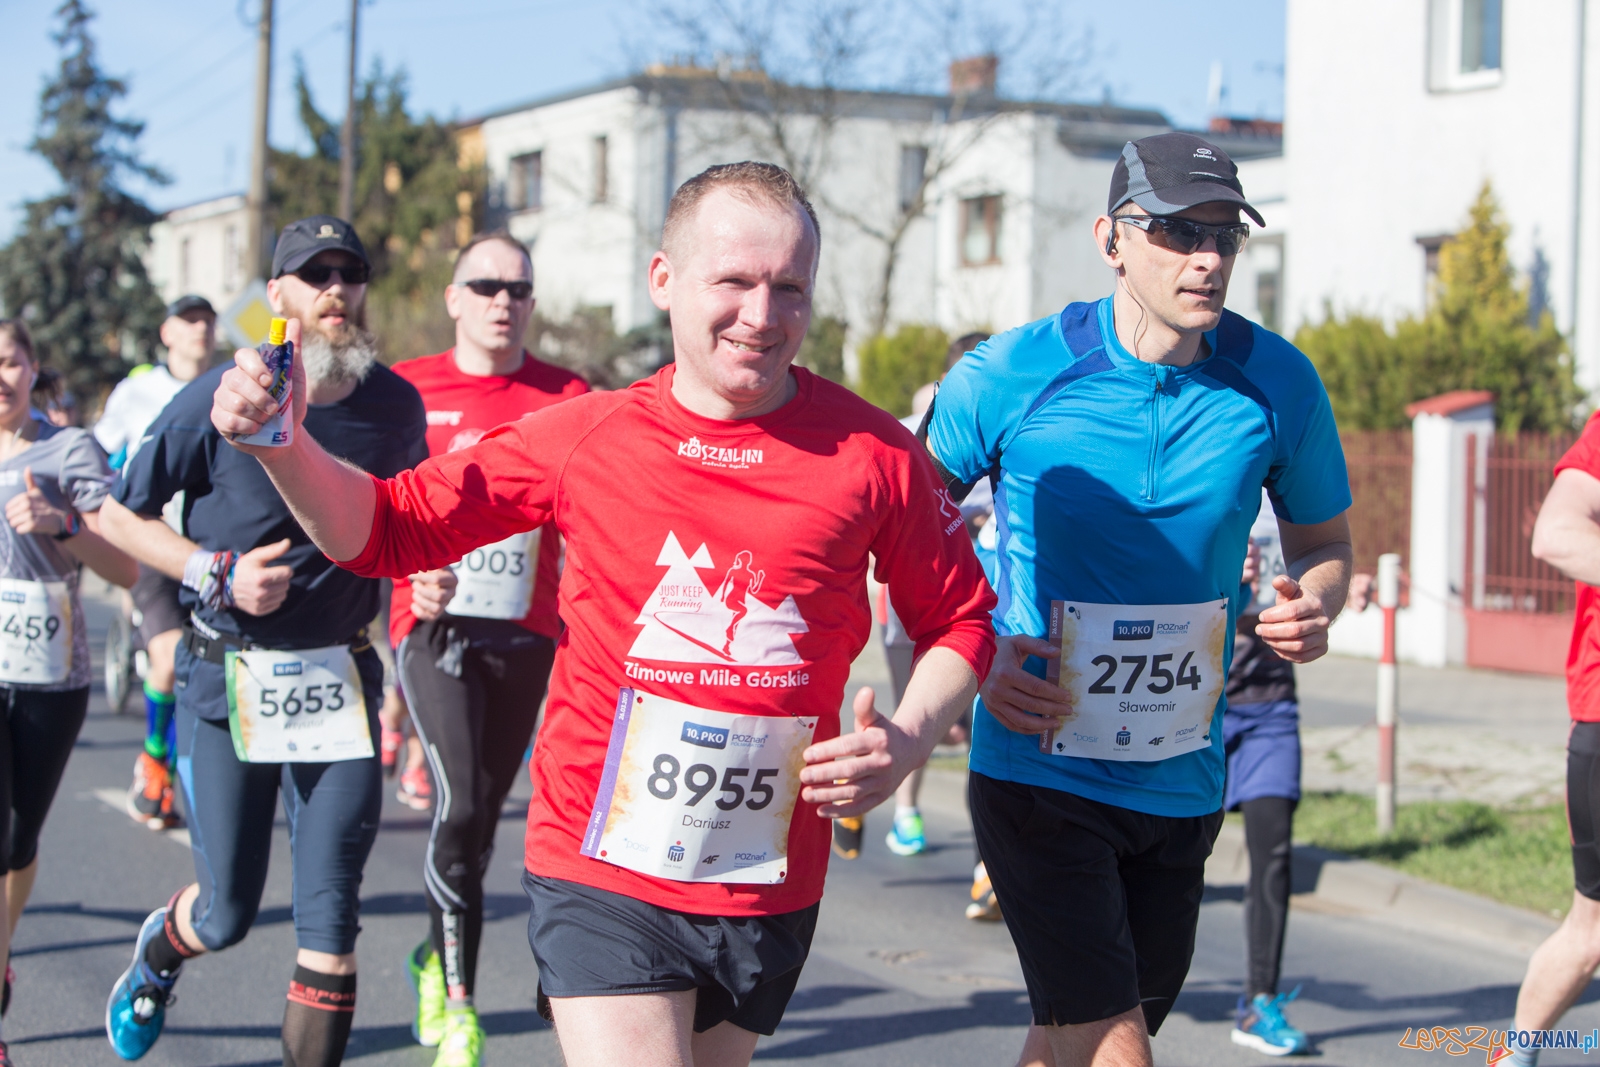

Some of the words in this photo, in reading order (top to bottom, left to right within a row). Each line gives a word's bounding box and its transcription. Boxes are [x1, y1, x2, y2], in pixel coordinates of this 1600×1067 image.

[677, 437, 763, 463] KOSZALIN
[451, 548, 524, 576] 003
[659, 585, 680, 597] JUST
[682, 585, 704, 598] KEEP
[659, 597, 703, 612] Running
[1051, 606, 1059, 635] 26.03.2017
[1117, 626, 1130, 635] 10.
[1131, 625, 1151, 635] PKO
[623, 661, 695, 685] Zimowe
[699, 669, 741, 686] Mile
[745, 670, 810, 688] Górskie
[1088, 650, 1202, 694] 2754
[259, 683, 344, 717] 5653
[618, 691, 629, 721] 26.03.2017
[1118, 700, 1177, 713] Sławomir
[686, 727, 700, 740] 10.
[700, 731, 725, 744] PKO
[1148, 736, 1165, 746] 4F
[647, 753, 779, 811] 8955
[681, 814, 732, 830] Dariusz
[702, 854, 720, 865] 4F
